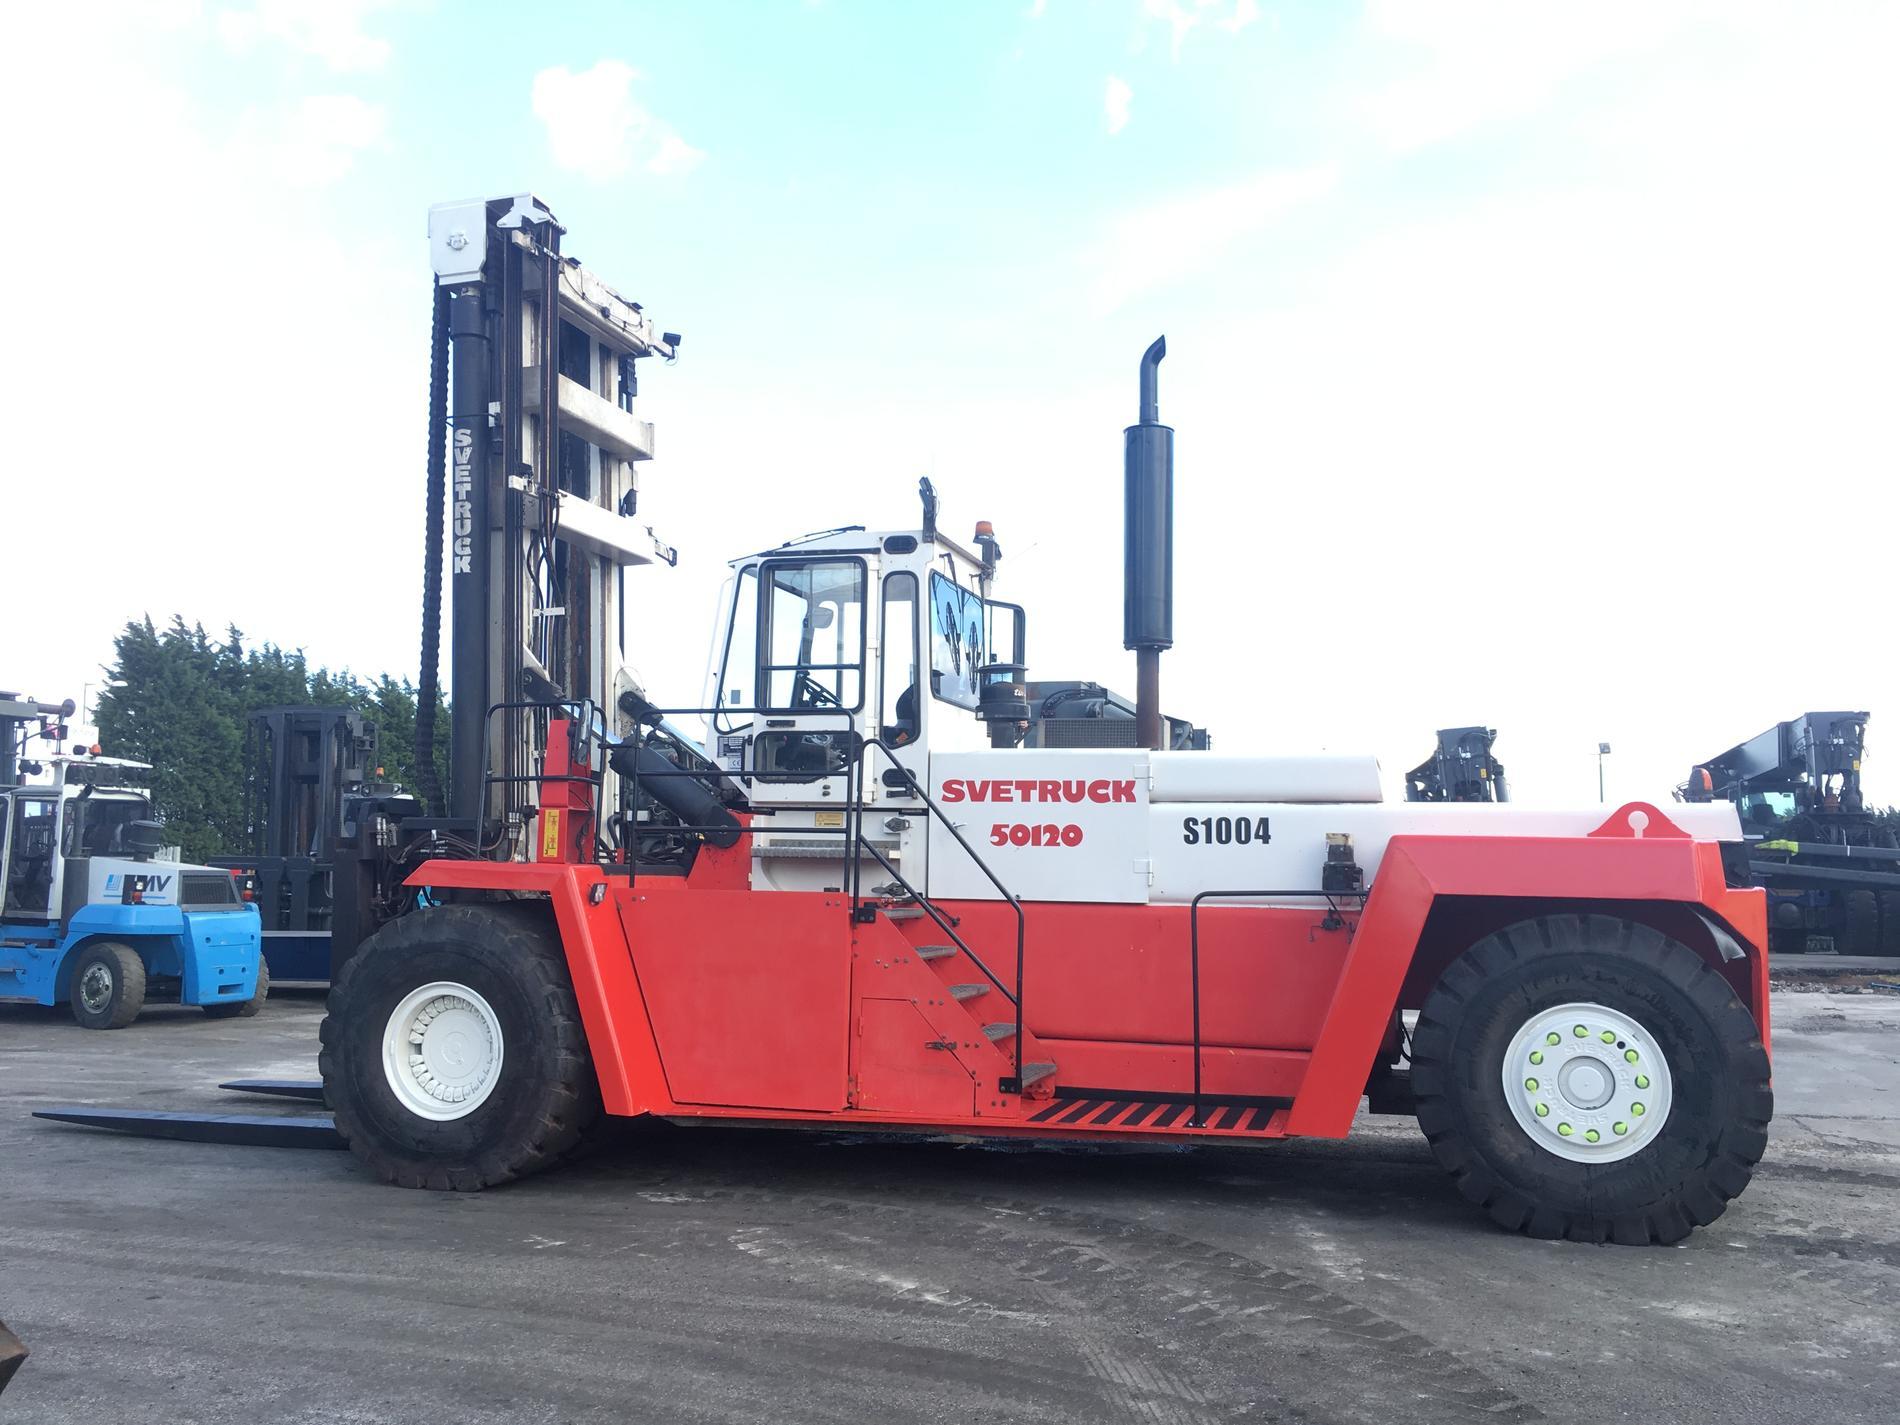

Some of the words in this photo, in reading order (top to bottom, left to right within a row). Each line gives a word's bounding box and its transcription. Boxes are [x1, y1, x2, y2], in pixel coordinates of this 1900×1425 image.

[454, 428, 472, 574] SVETRUCK
[941, 779, 1137, 803] SVETRUCK
[989, 823, 1084, 847] 50120
[1183, 816, 1272, 845] S1004
